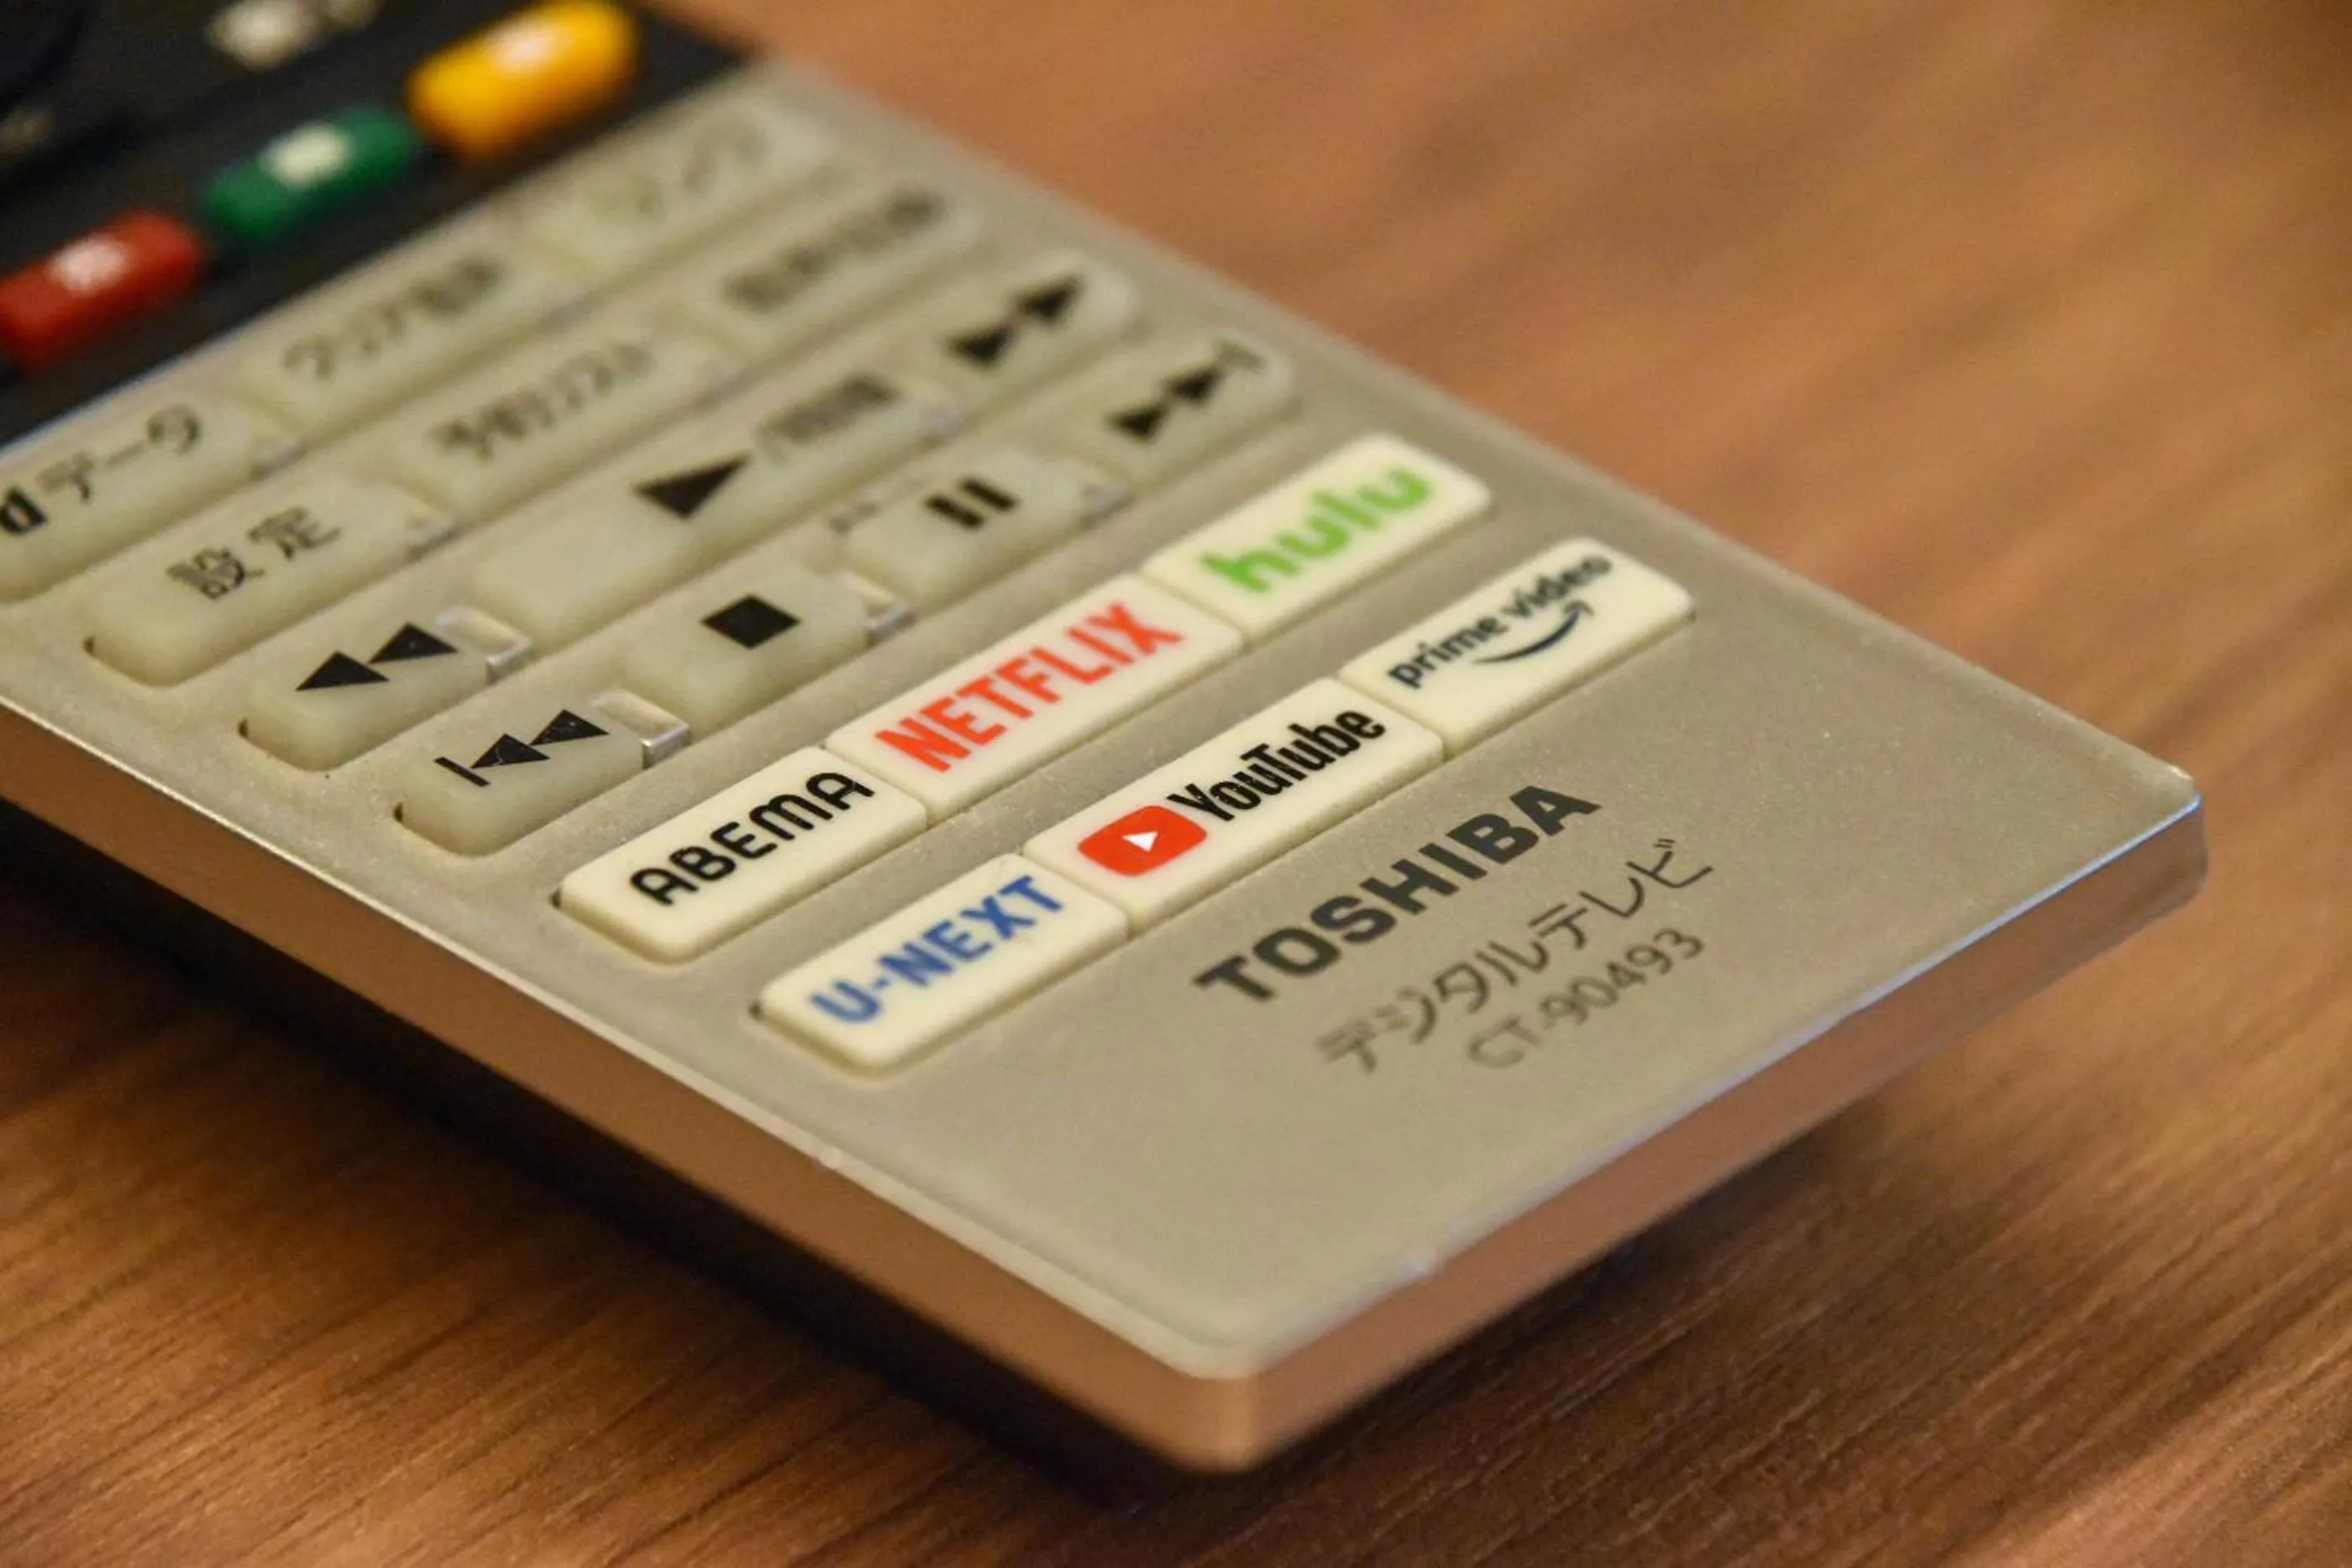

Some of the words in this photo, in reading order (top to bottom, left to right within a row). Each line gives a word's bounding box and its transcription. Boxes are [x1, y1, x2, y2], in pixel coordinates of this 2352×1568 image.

[1198, 465, 1436, 594] hulu
[874, 601, 1184, 773] NETFLIX
[1387, 611, 1510, 690] prime
[1500, 554, 1614, 621] video
[1167, 710, 1386, 823] YouTube
[629, 772, 876, 906] ABEMA
[1192, 785, 1602, 1004] TOSHIBA
[809, 874, 1064, 1025] U-NEXT
[1316, 838, 1714, 1075] デジタルテレビ
[1467, 927, 1706, 1069] CT-90493
